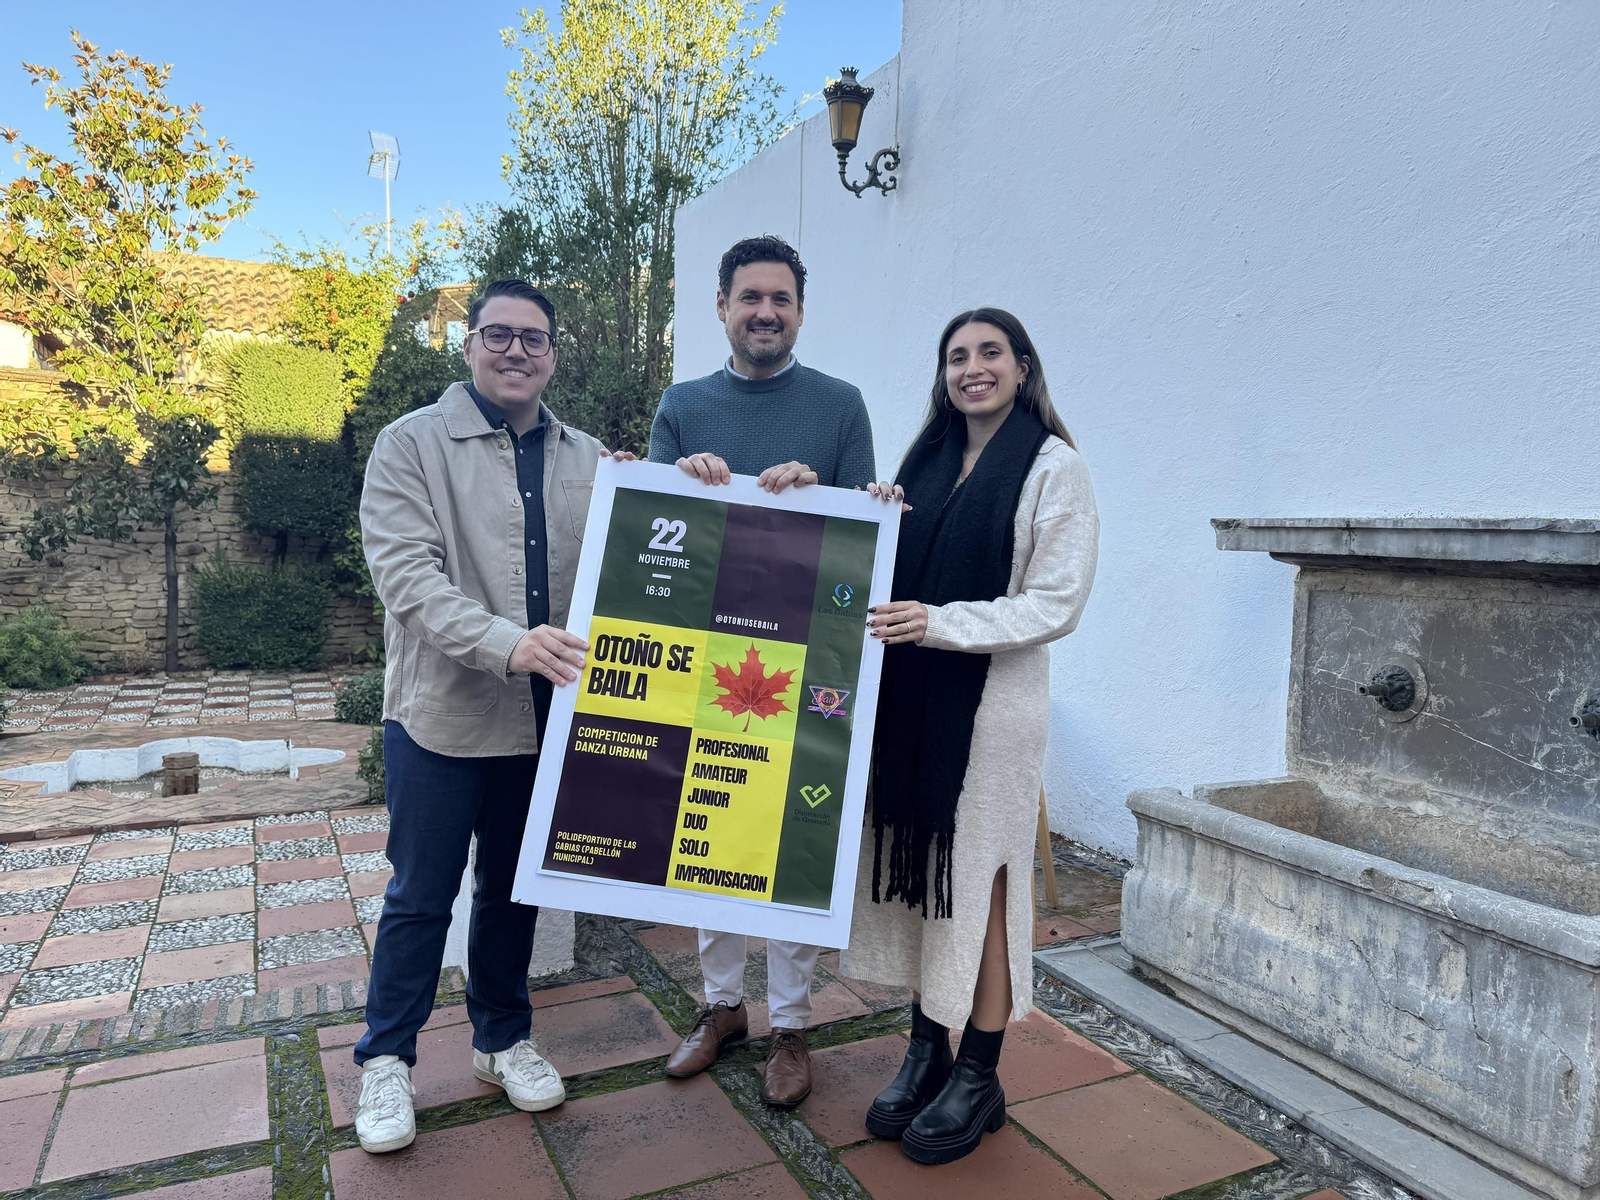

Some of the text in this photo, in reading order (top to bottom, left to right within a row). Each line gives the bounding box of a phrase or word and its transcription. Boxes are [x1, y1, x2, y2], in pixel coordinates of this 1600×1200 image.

[648, 517, 687, 552] 22
[638, 554, 690, 570] NOVIEMBRE
[646, 584, 671, 598] 16:30
[818, 606, 863, 618] Las Gabias
[594, 632, 694, 673] OTOÑO SE
[587, 667, 648, 701] BAILA
[578, 726, 659, 748] COMPETICION DE
[575, 741, 648, 760] DANZA URBANA
[696, 738, 770, 762] PROFESIONAL
[691, 762, 747, 784] AMATEUR
[688, 788, 730, 808] JUNIOR
[683, 812, 708, 831] DUO
[802, 816, 830, 826] Granada
[555, 842, 580, 853] GABIAS
[557, 831, 637, 849] POLIDEPORTIVO DE LAS
[679, 838, 710, 857] SOLO
[675, 864, 768, 893] IMPROVISACION
